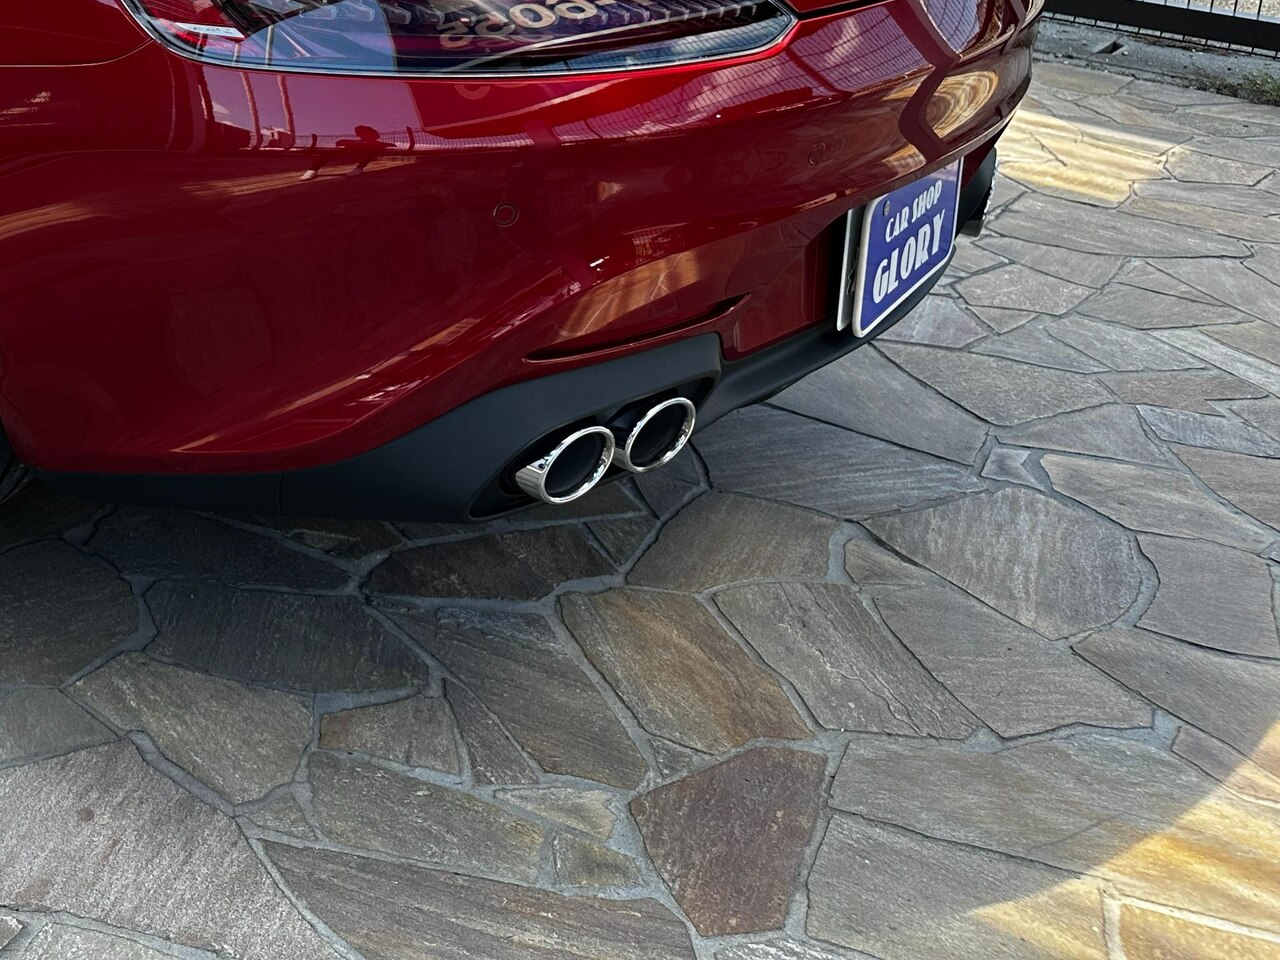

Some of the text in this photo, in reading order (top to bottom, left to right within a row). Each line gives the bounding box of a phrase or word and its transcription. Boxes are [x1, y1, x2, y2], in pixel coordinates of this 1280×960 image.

[885, 179, 943, 243] CAR SHOP
[872, 208, 946, 304] GLORY
